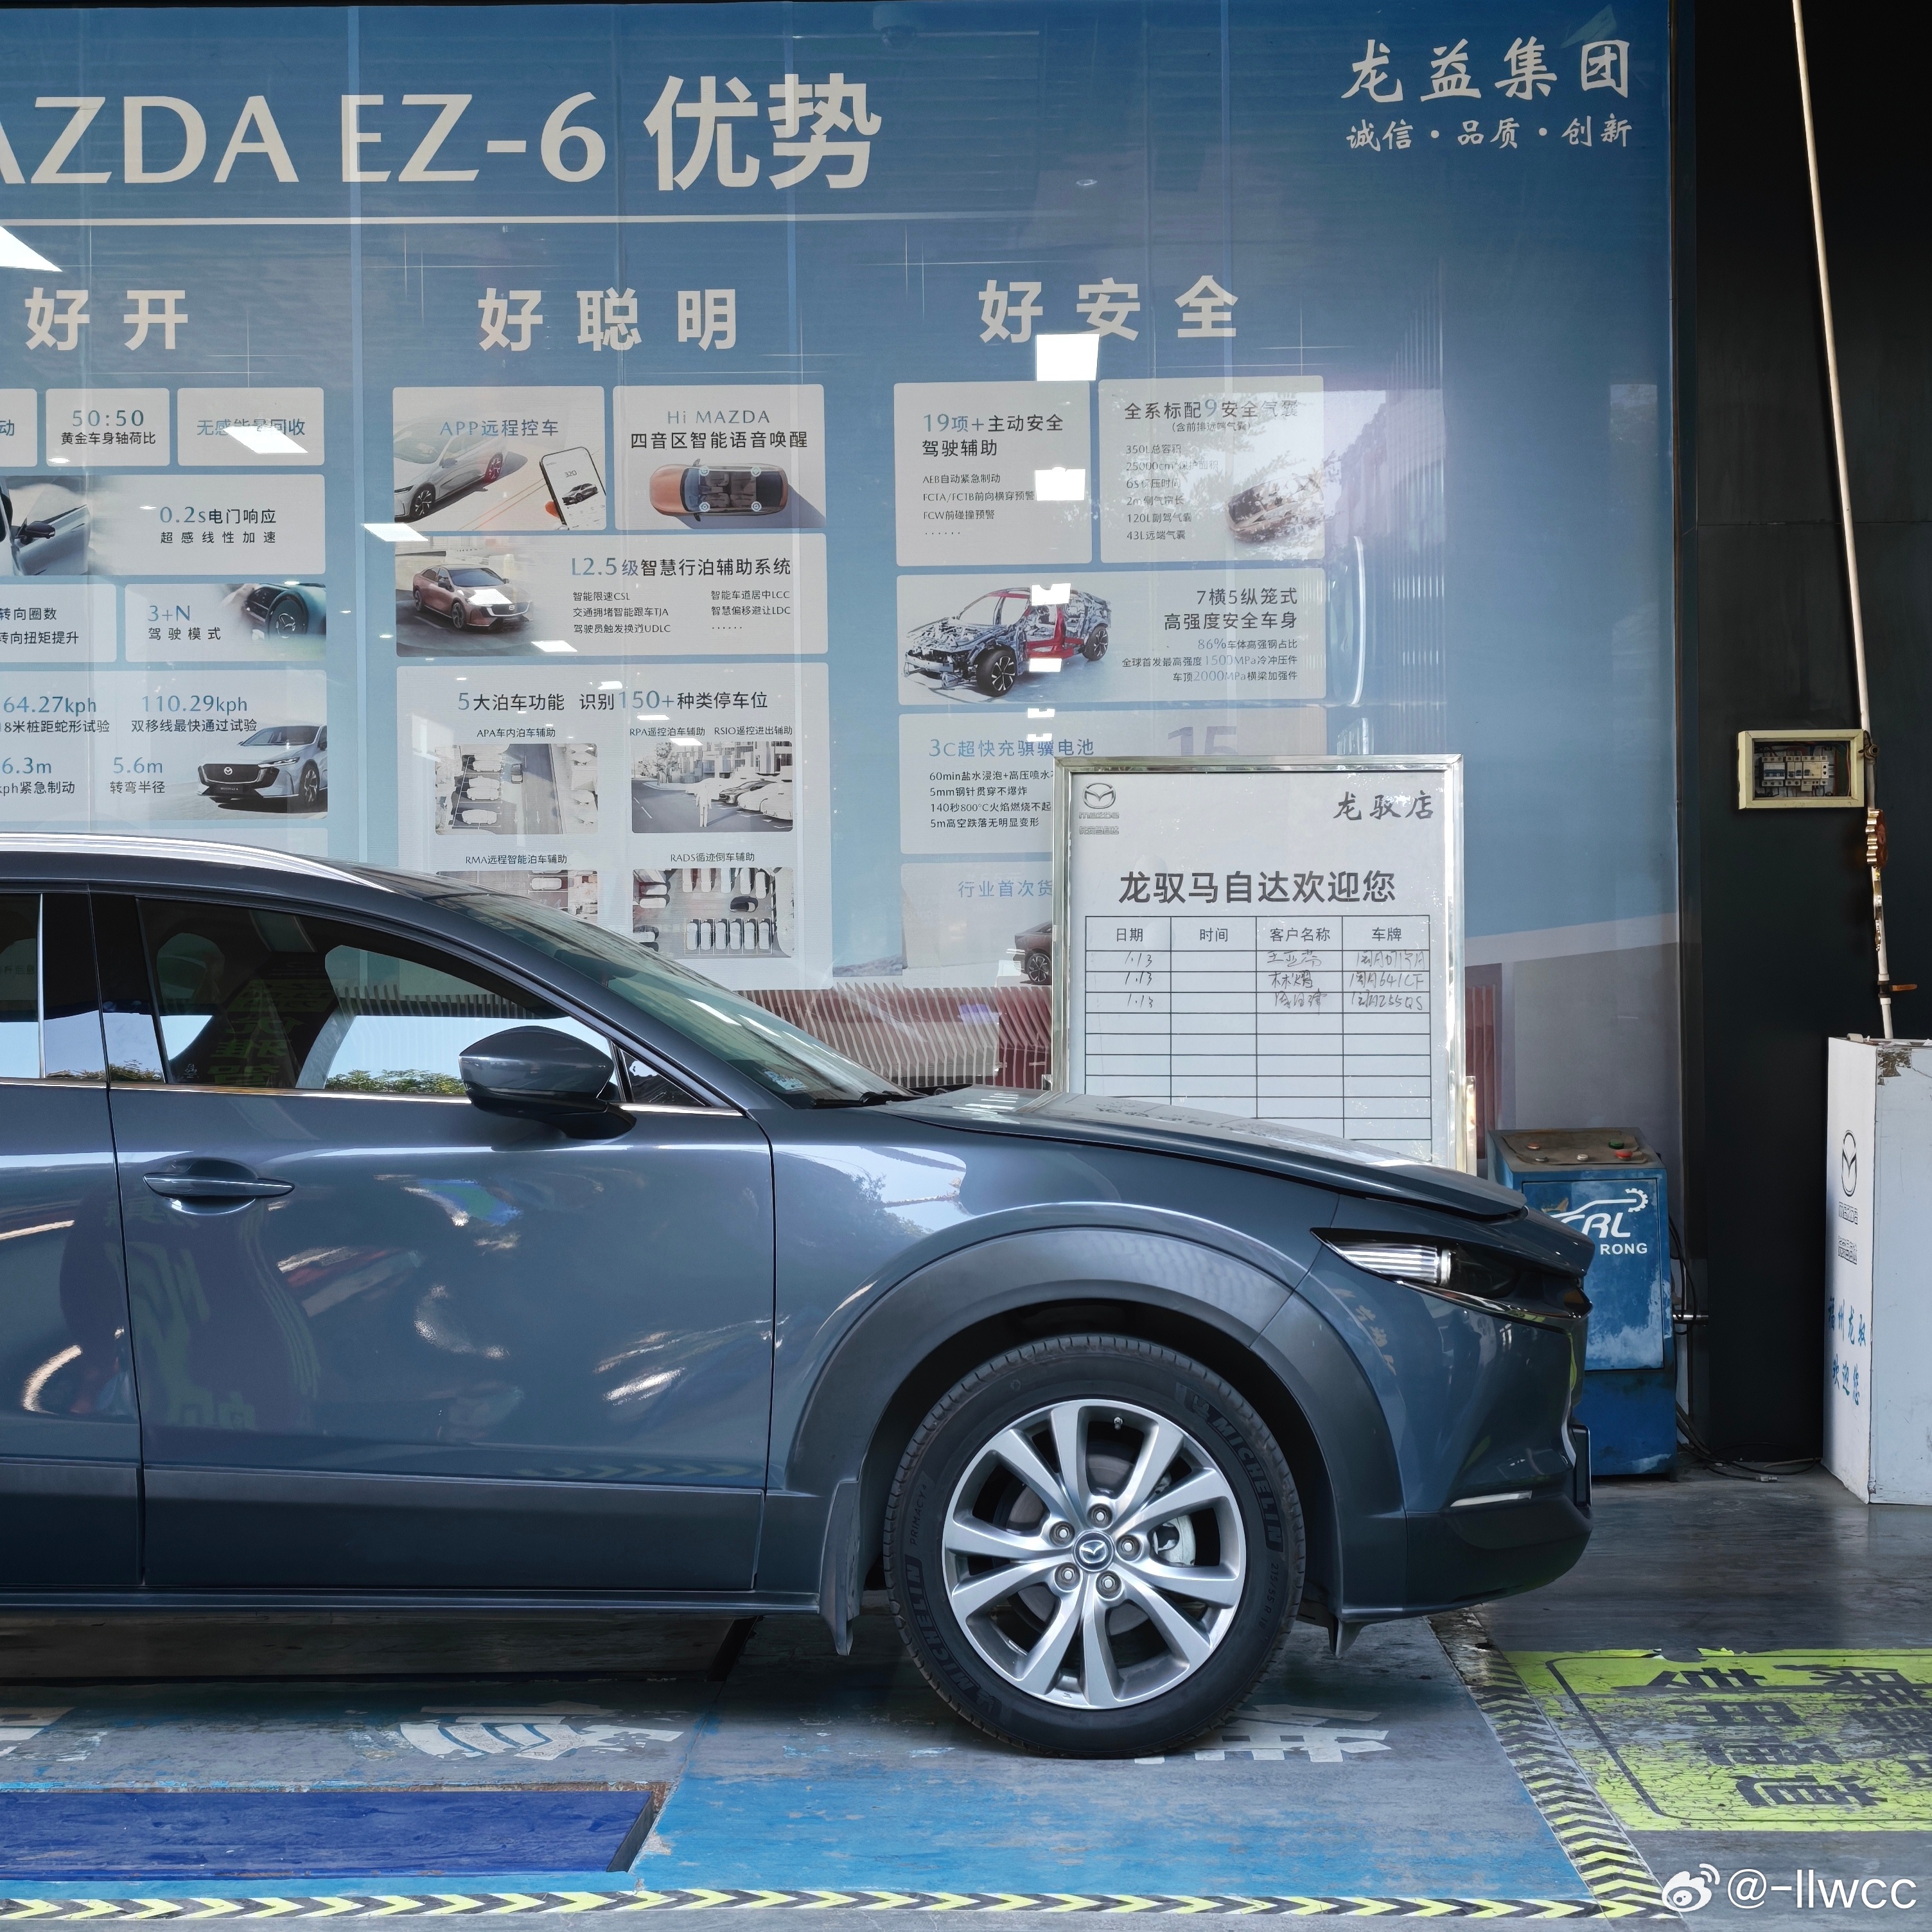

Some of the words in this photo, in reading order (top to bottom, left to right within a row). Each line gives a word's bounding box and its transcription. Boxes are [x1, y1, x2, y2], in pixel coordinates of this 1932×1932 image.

[1341, 37, 1630, 103] 龙益集团
[342, 91, 606, 182] EZ-6
[643, 72, 882, 191] 优势
[978, 275, 1240, 344] 好安全
[25, 287, 188, 351] 好开
[479, 287, 737, 352] 好聪明
[73, 410, 144, 426] 50:50
[667, 410, 688, 425] Hi
[696, 410, 771, 424] MAZDA
[924, 414, 1063, 432] 19项+主动安全
[439, 418, 559, 437] APP远程控车
[61, 432, 155, 445] 黄金车身轴荷比
[630, 431, 808, 450] 四音区智能语音唤醒
[922, 439, 997, 457] 驾驶辅助
[1126, 444, 1181, 454] 350L总容积
[922, 473, 1001, 484] AEB自动紧急制动
[159, 506, 277, 524] 0.2s电门响应
[924, 509, 995, 520] FCW前碰撞预警
[161, 532, 276, 544] 超感线性加速
[571, 557, 792, 577] L2.5级智慧行泊辅助系统
[573, 591, 630, 602] 智能限速CSL
[710, 590, 791, 601] 智能车道居中LCC
[1197, 587, 1297, 606] 7横5纵笼式
[0, 608, 57, 620] 转向圈数
[148, 605, 191, 622] 3+N
[573, 606, 669, 618] 交通拥堵智能跟车TJA
[573, 623, 671, 634] 驾驶员触发换道UDLC
[1164, 611, 1297, 631] 高强度安全车身
[148, 627, 221, 640] 驾驶模式
[3, 696, 97, 717] 64.27kph
[142, 695, 247, 715] 110.29kph
[458, 692, 565, 712] 5大泊车功能
[579, 690, 768, 710] 识别150+种类停车位
[132, 719, 258, 733] 双移线最快通过试验
[477, 727, 556, 739] APA车内泊车辅助
[629, 726, 706, 737] RPA遥控泊车辅助
[2, 757, 51, 774] 6.3m
[114, 757, 163, 774] 5.6m
[110, 781, 165, 794] 转弯半径
[930, 786, 1028, 796] 5mm钢针贯穿不爆炸
[931, 817, 1039, 828] 5m高空跌落无明显变形
[465, 854, 567, 865] RMA远程智能泊车辅助
[670, 852, 755, 863] RADS循迹倒车辅助
[1118, 870, 1396, 904] 龙驭马自达欢迎您
[1116, 927, 1143, 942] 日期
[1200, 927, 1229, 942] 时间
[1270, 927, 1331, 942] 客户名称
[1371, 927, 1402, 942] 车牌
[1600, 1243, 1647, 1255] RONG
[909, 1491, 926, 1546] PRIMACY
